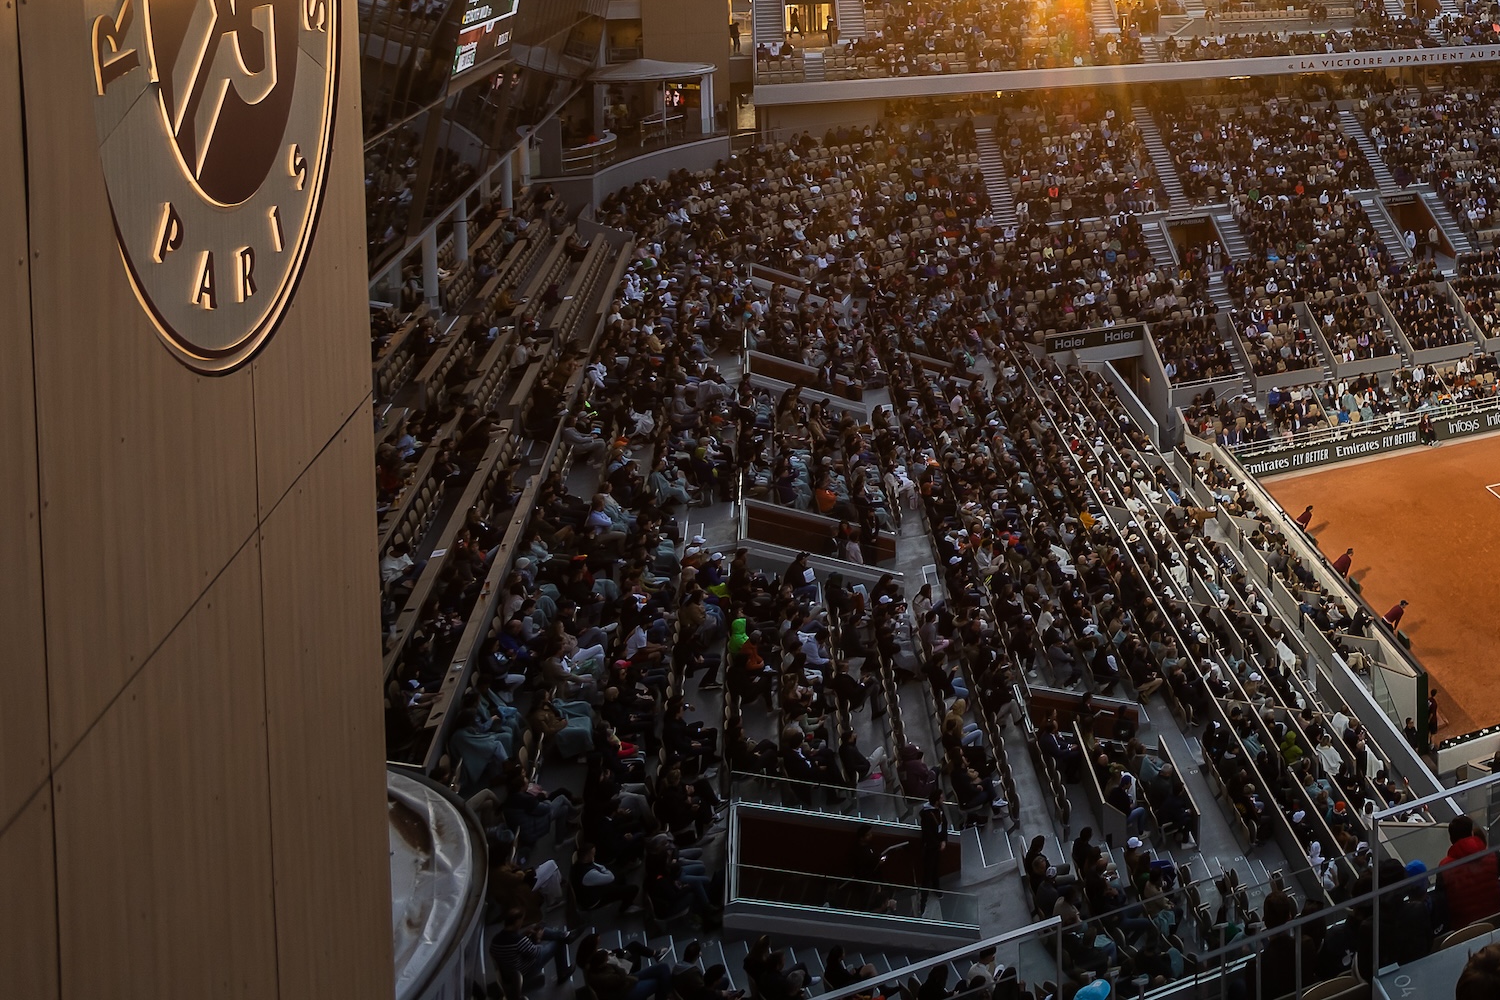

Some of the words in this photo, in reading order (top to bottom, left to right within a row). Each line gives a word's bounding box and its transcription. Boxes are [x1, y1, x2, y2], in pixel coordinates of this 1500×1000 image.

[1301, 61, 1315, 69] LA
[1322, 57, 1382, 68] VICTOIRE
[1389, 52, 1465, 64] APPARTIENT
[1470, 50, 1485, 58] AU
[153, 143, 307, 310] PARIS
[1055, 338, 1086, 350] Haier
[1104, 330, 1135, 342] Haier
[1448, 418, 1480, 434] Infosys
[1335, 441, 1380, 458] Emirates
[1382, 436, 1394, 449] FLY
[1394, 431, 1418, 446] BETTER
[1243, 458, 1290, 475] Emirates
[1292, 453, 1305, 467] FLY
[1305, 448, 1329, 464] BETTER
